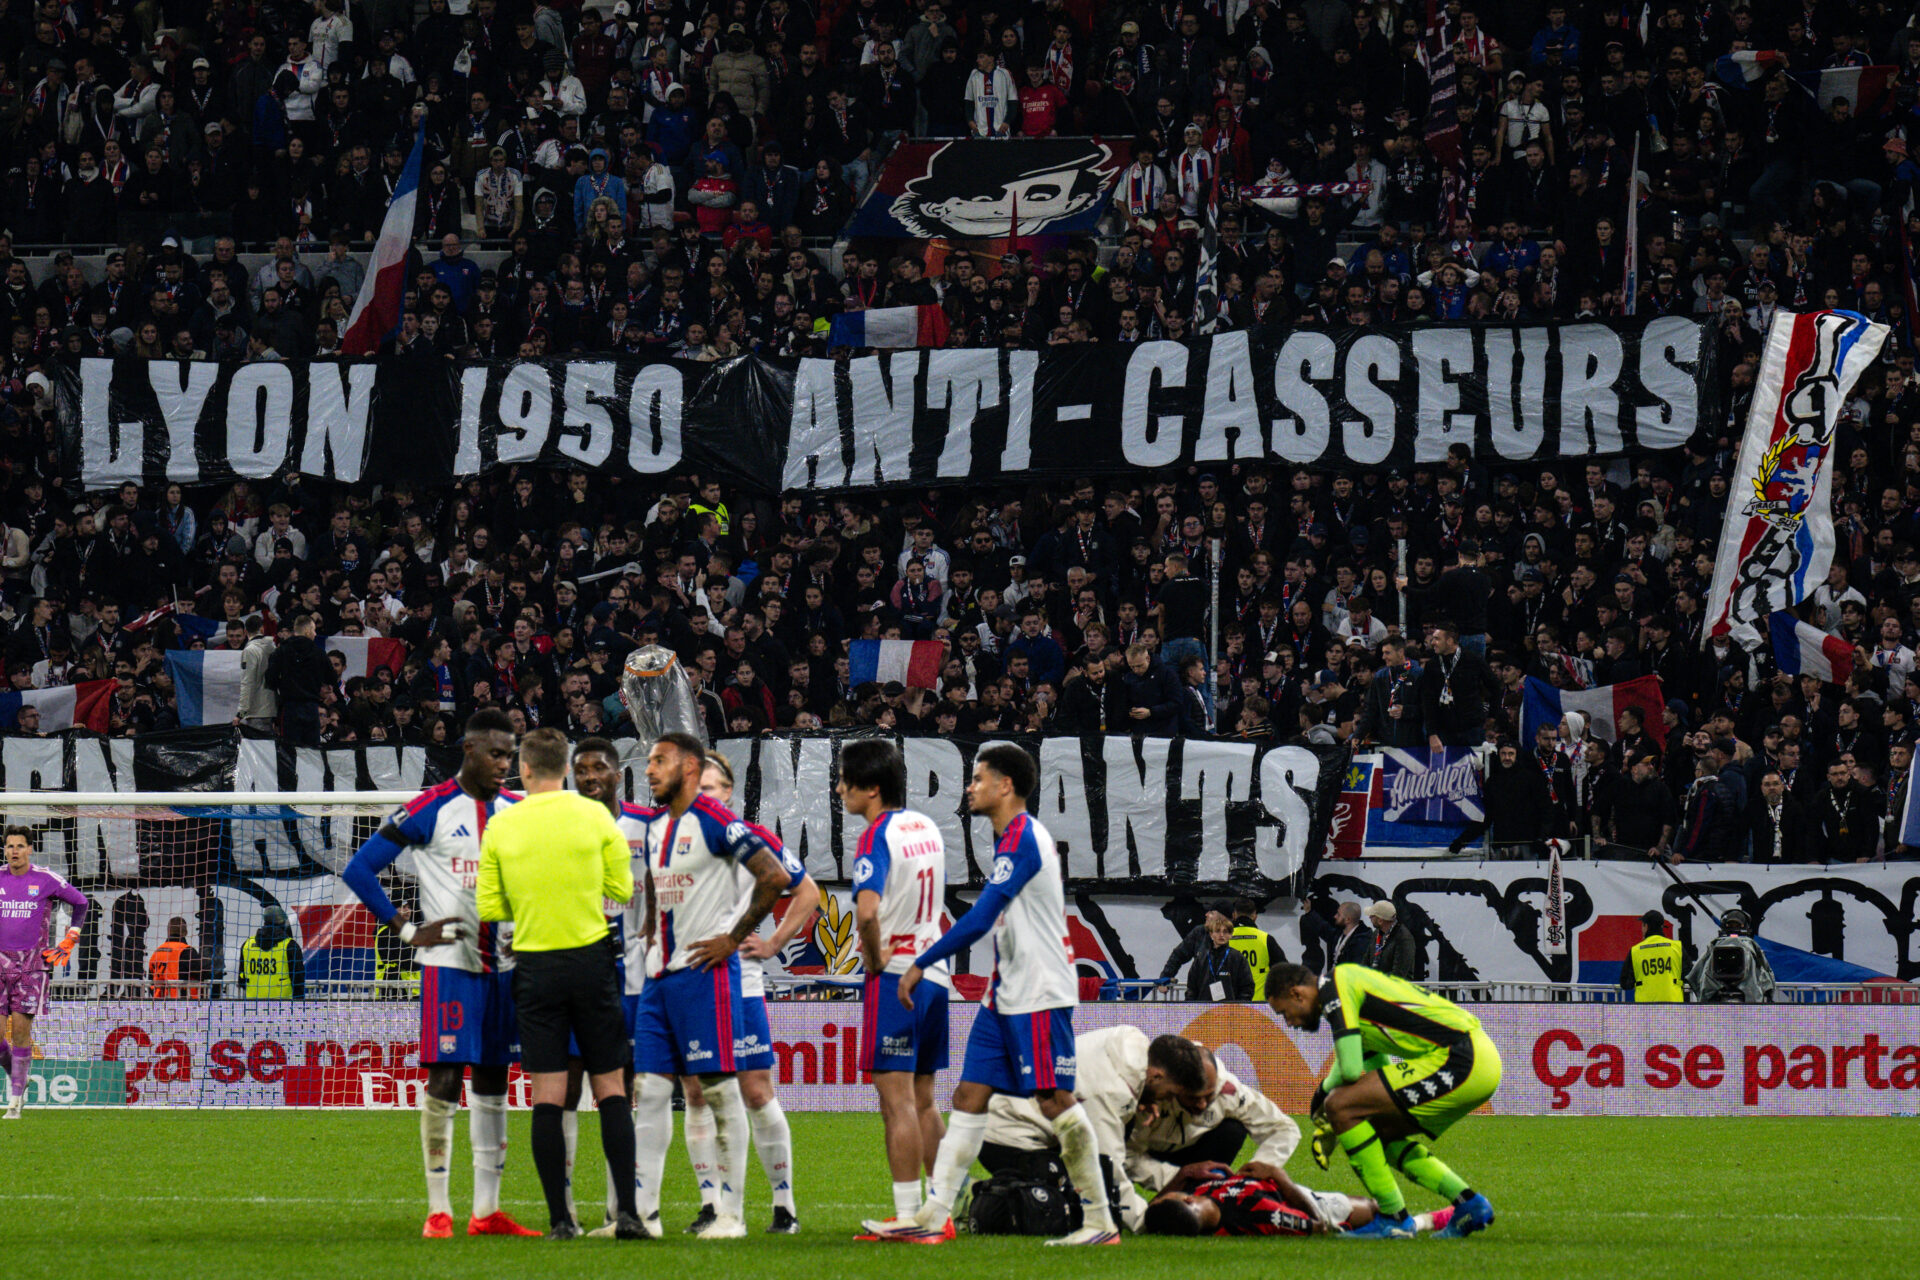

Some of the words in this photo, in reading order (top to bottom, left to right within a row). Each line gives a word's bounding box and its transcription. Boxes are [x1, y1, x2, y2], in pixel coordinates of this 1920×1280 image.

[80, 357, 377, 492] LYON
[453, 361, 684, 475] 1950
[652, 873, 694, 888] mirates
[0, 900, 38, 910] mirates
[915, 867, 934, 924] 11
[250, 958, 277, 975] 0583
[1641, 957, 1672, 977] 0594
[439, 1001, 464, 1030] 19
[210, 1040, 287, 1083] se
[1532, 1029, 1625, 1109] Ça
[1644, 1044, 1726, 1088] se
